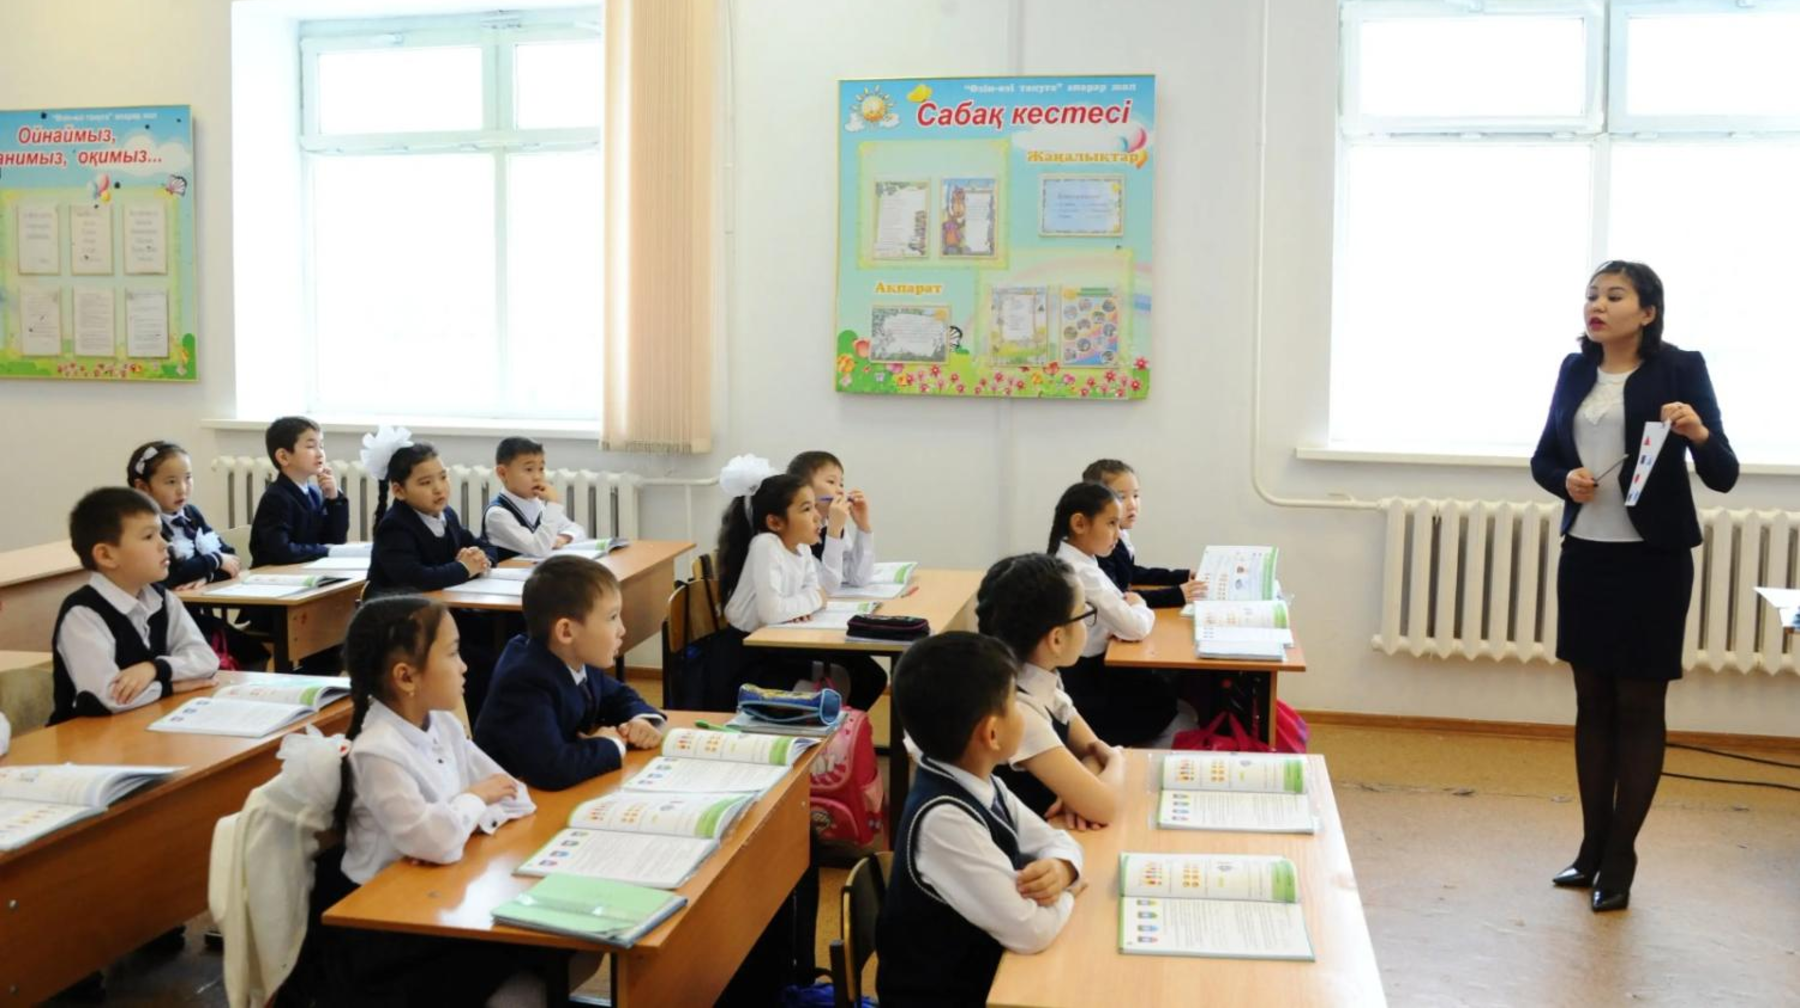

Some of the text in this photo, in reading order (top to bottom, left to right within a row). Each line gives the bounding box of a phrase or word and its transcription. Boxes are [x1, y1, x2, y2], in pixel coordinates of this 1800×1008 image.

[917, 100, 1131, 129] Сабақ кестесі
[18, 125, 116, 144] Ойнаймыз,
